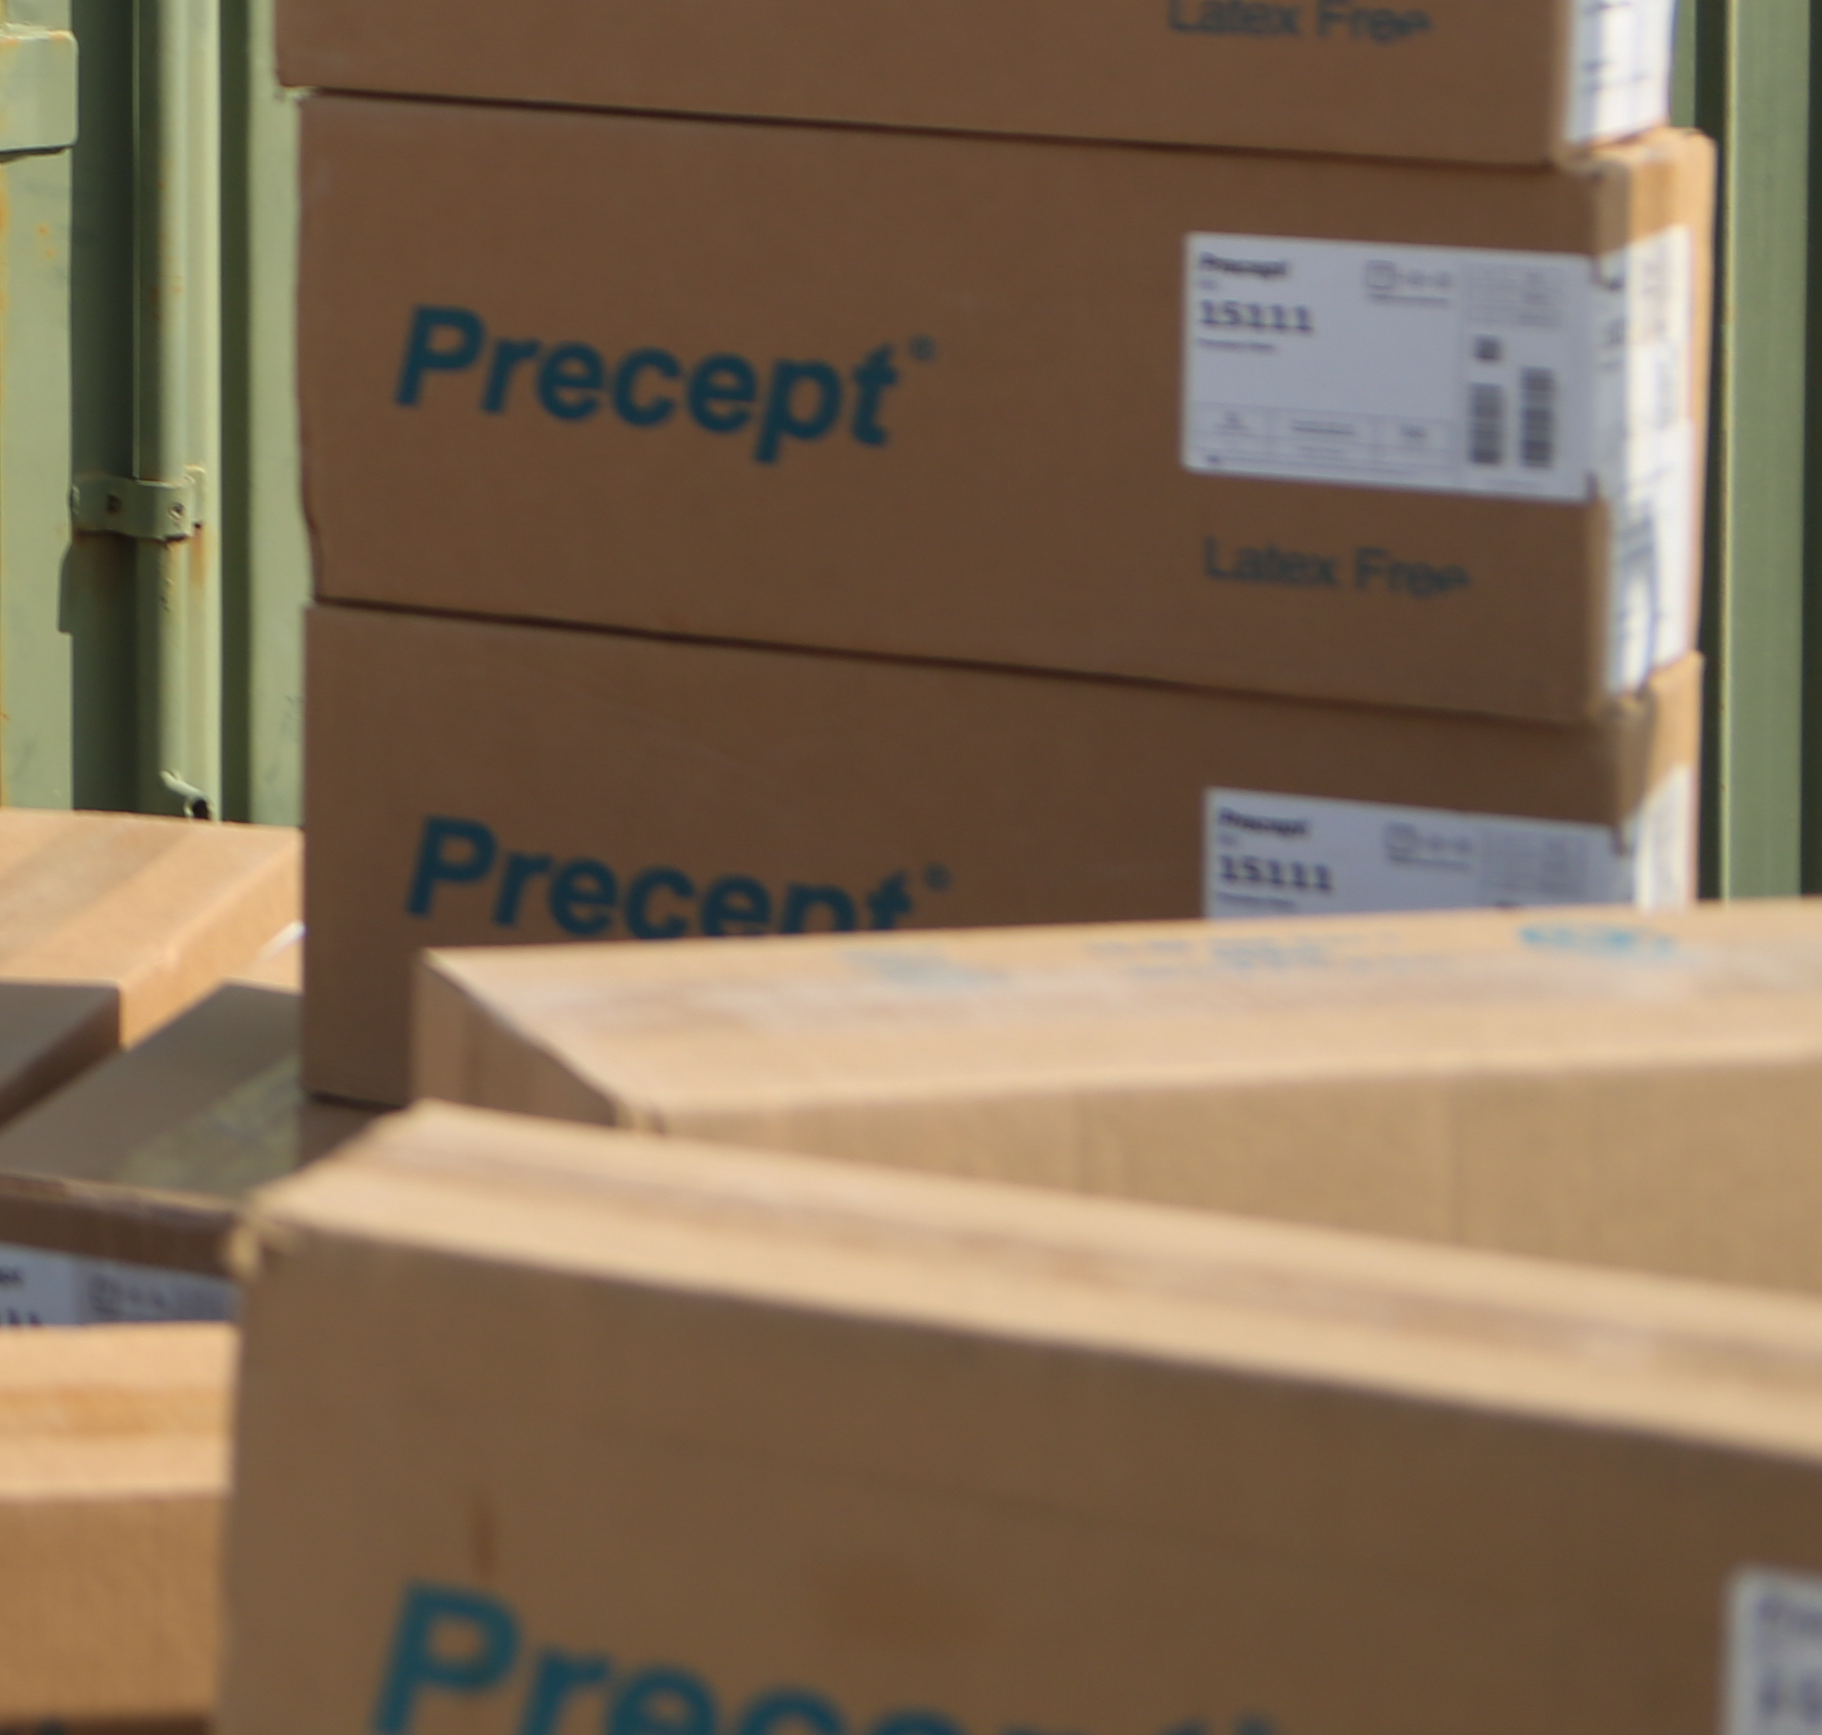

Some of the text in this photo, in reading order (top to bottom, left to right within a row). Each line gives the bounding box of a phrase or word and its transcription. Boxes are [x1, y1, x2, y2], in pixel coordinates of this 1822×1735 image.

[1200, 299, 1315, 332] 15111
[393, 304, 900, 464] Precept
[1204, 536, 1339, 588] Latex
[1221, 854, 1334, 893] 15111
